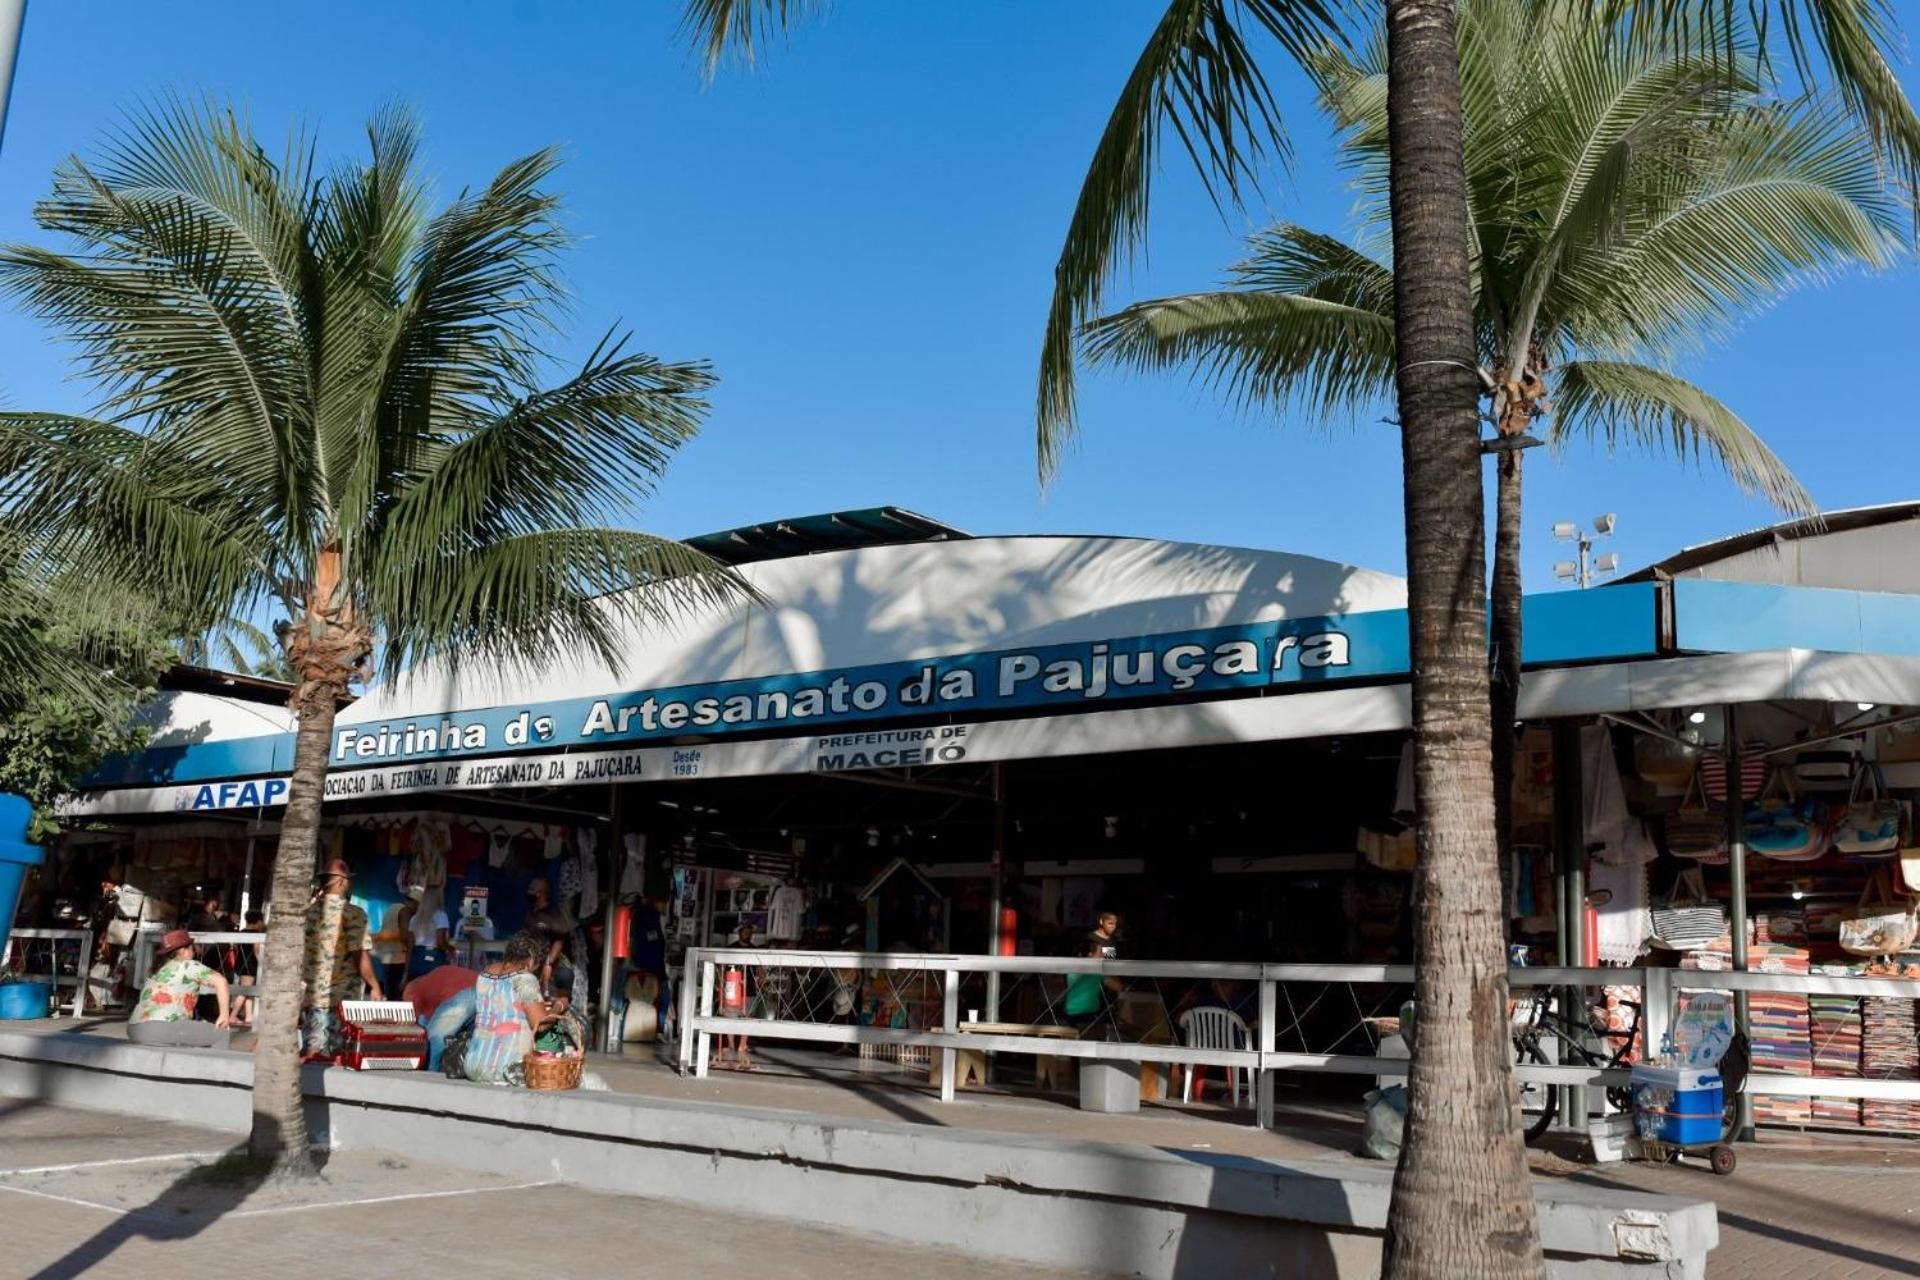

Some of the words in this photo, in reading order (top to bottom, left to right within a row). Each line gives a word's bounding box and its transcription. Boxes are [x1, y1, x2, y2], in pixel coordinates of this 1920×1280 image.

[335, 719, 487, 761] Feirinha
[504, 711, 557, 745] de
[580, 676, 888, 737] Artesanato
[898, 666, 976, 706] da
[998, 631, 1351, 698] Pajuçara
[818, 729, 936, 749] PREFEITURA
[940, 726, 967, 739] DE
[673, 749, 701, 763] Desde
[673, 764, 698, 776] 1983
[816, 741, 966, 771] MACEIÓ
[371, 774, 385, 792] DA
[390, 768, 438, 790] FEIRINHA
[445, 766, 462, 785] DE
[466, 762, 543, 786] ARTESANATO
[548, 760, 565, 780] DA
[191, 780, 287, 810] AFAP
